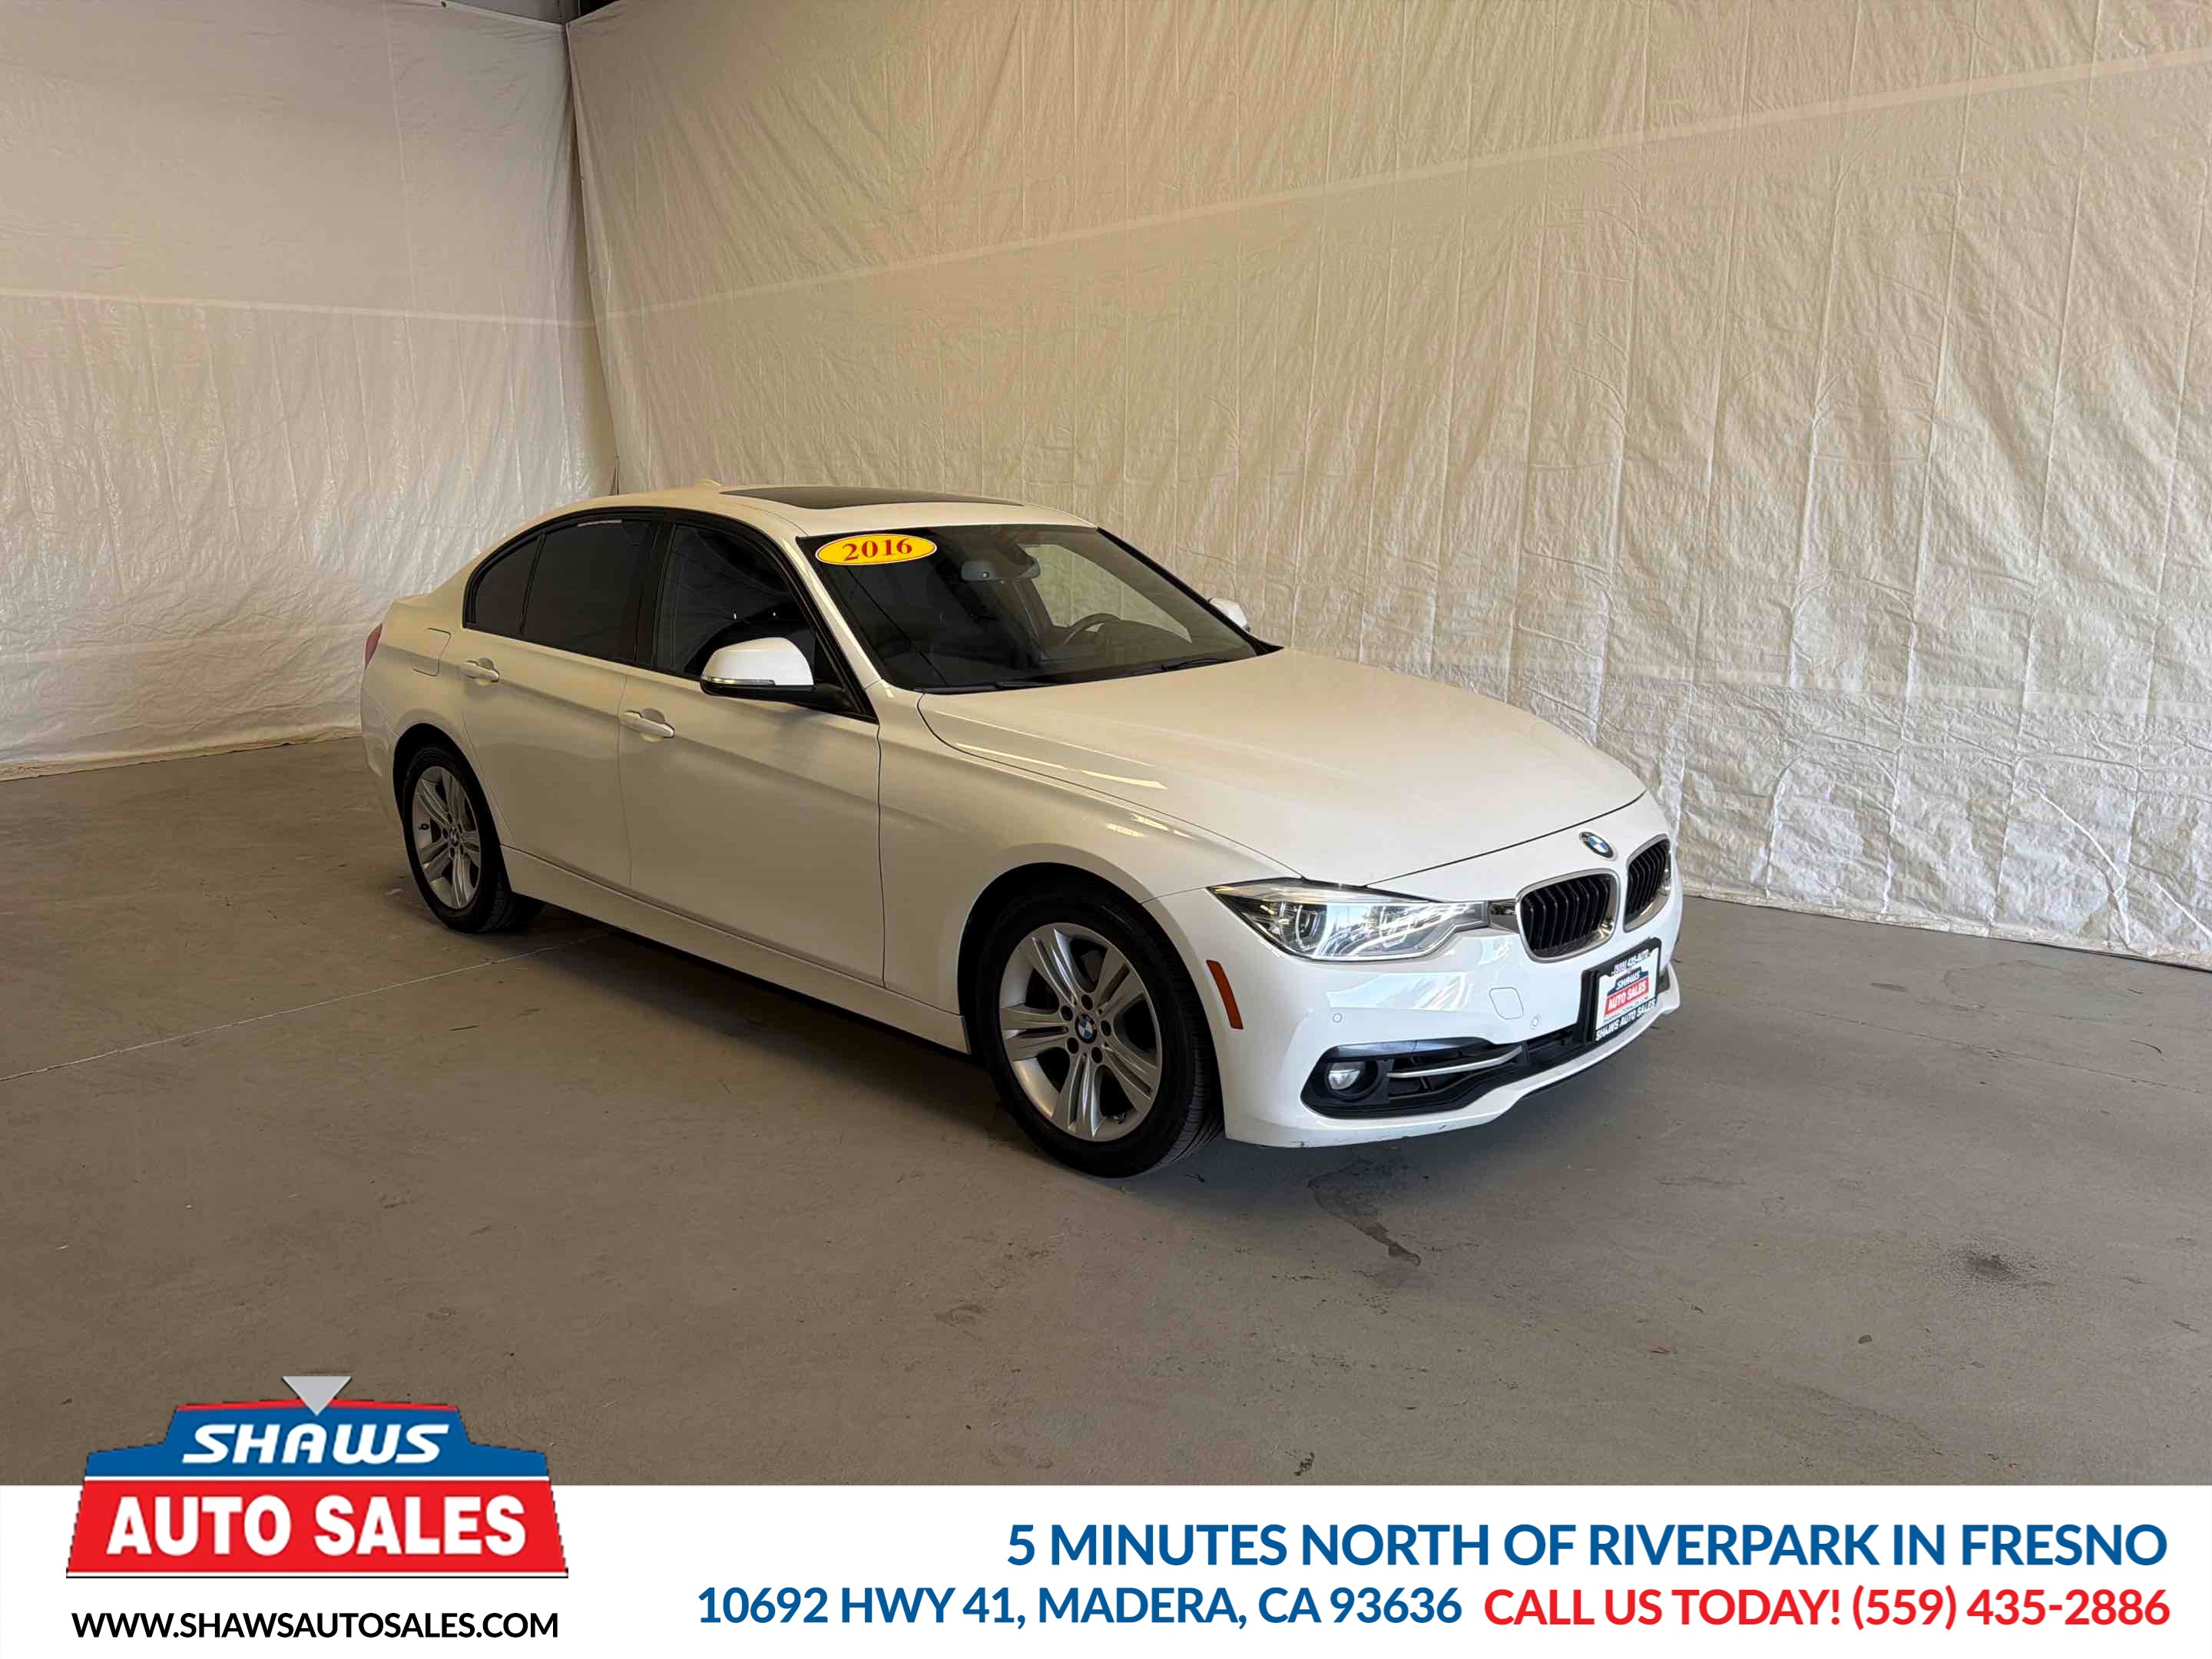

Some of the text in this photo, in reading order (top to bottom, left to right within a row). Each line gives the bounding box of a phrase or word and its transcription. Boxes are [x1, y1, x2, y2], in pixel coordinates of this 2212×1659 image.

[842, 538, 913, 561] 2016
[1615, 971, 1641, 991] SHAWS
[1608, 992, 1626, 1011] AUTO
[1626, 979, 1647, 1001] SALES
[1595, 1018, 1620, 1041] SHAWS
[1619, 1008, 1637, 1028] AUTO
[1636, 998, 1656, 1018] SALES
